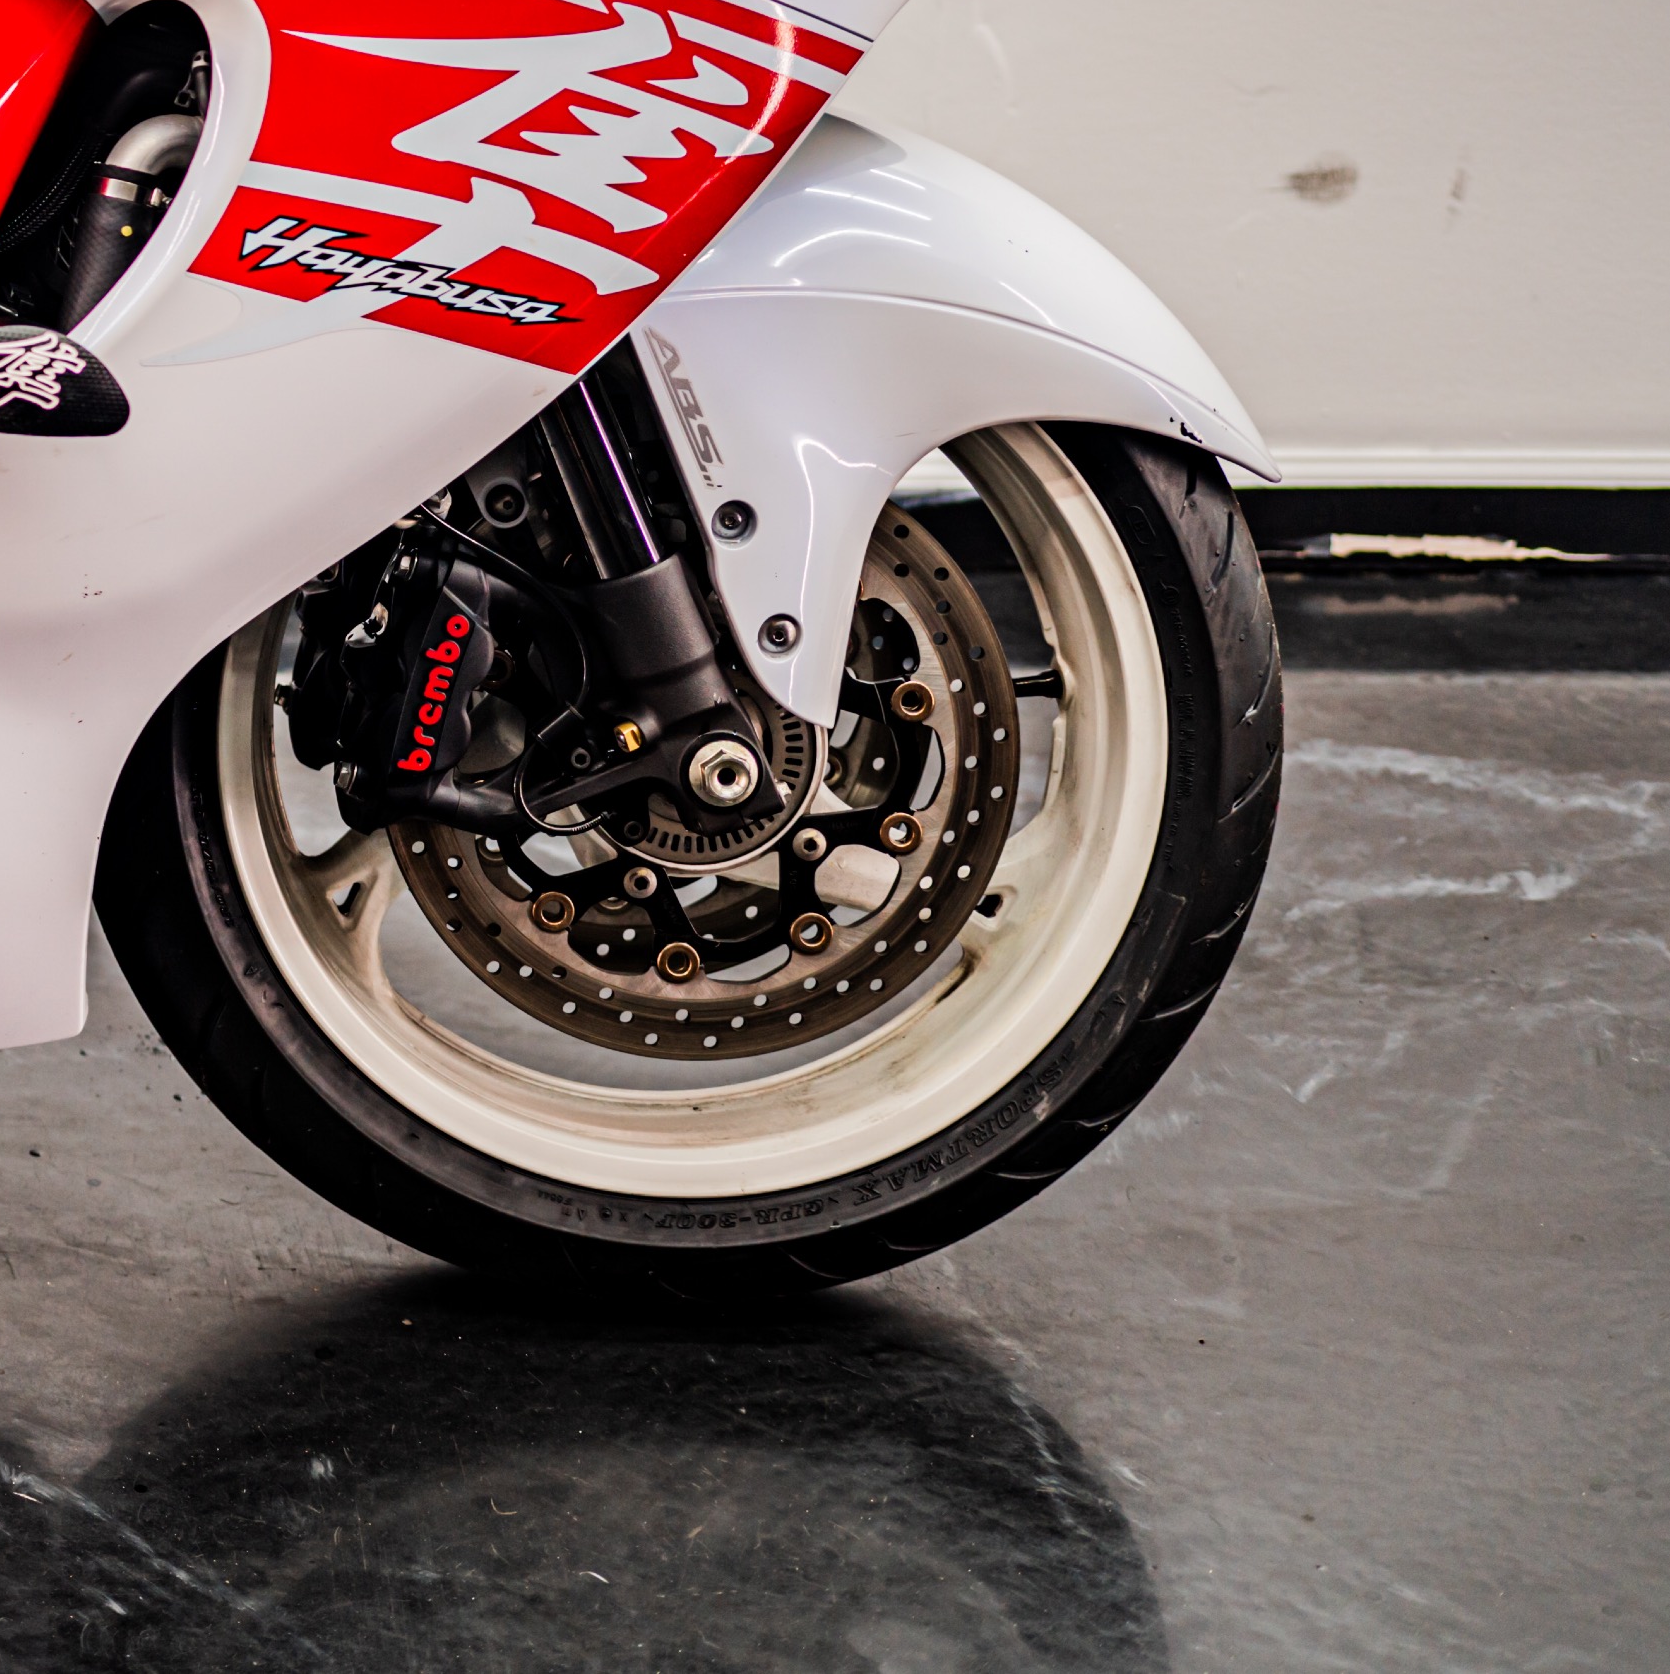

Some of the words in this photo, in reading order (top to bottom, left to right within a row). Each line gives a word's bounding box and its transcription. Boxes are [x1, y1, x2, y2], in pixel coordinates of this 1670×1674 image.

[239, 215, 575, 325] Hayabusa
[642, 326, 724, 467] ABS
[397, 614, 470, 772] brembo
[853, 1065, 1064, 1208] SPORTMAX
